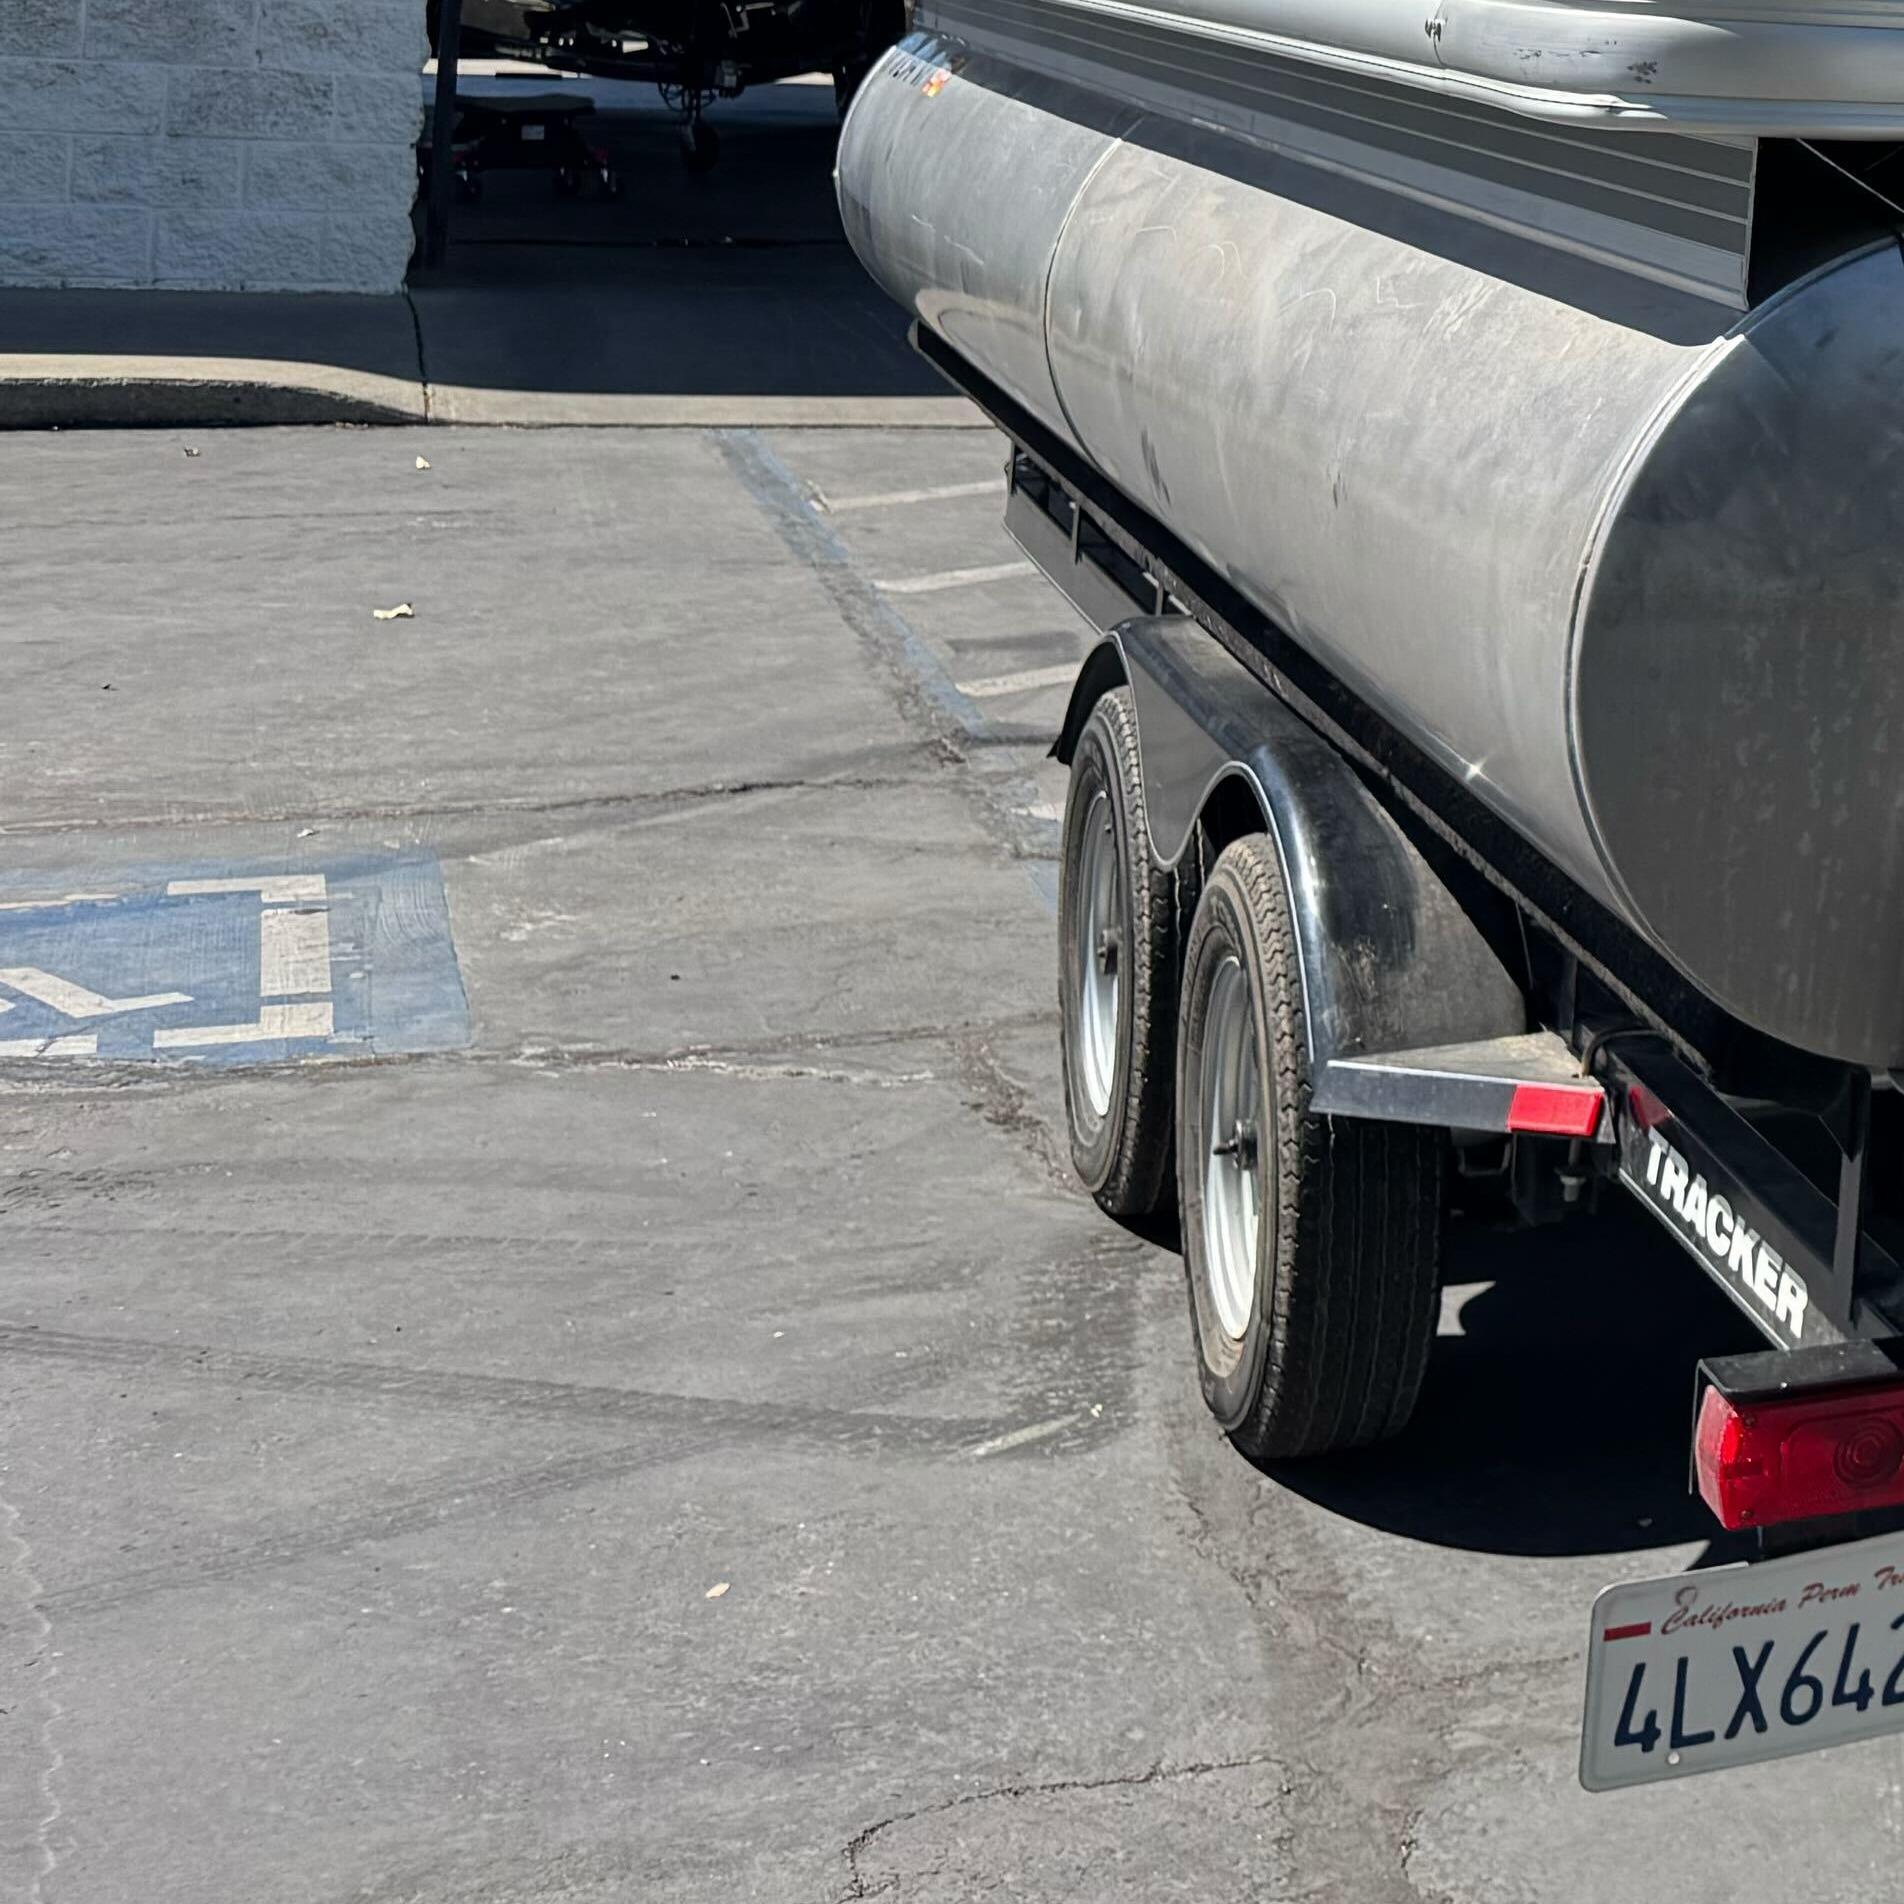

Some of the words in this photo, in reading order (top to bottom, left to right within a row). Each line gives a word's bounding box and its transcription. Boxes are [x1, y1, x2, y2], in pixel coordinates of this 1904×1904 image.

[1644, 1125, 1810, 1339] TRACKER
[1660, 1598, 1787, 1635] California
[1798, 1581, 1861, 1609] Perm
